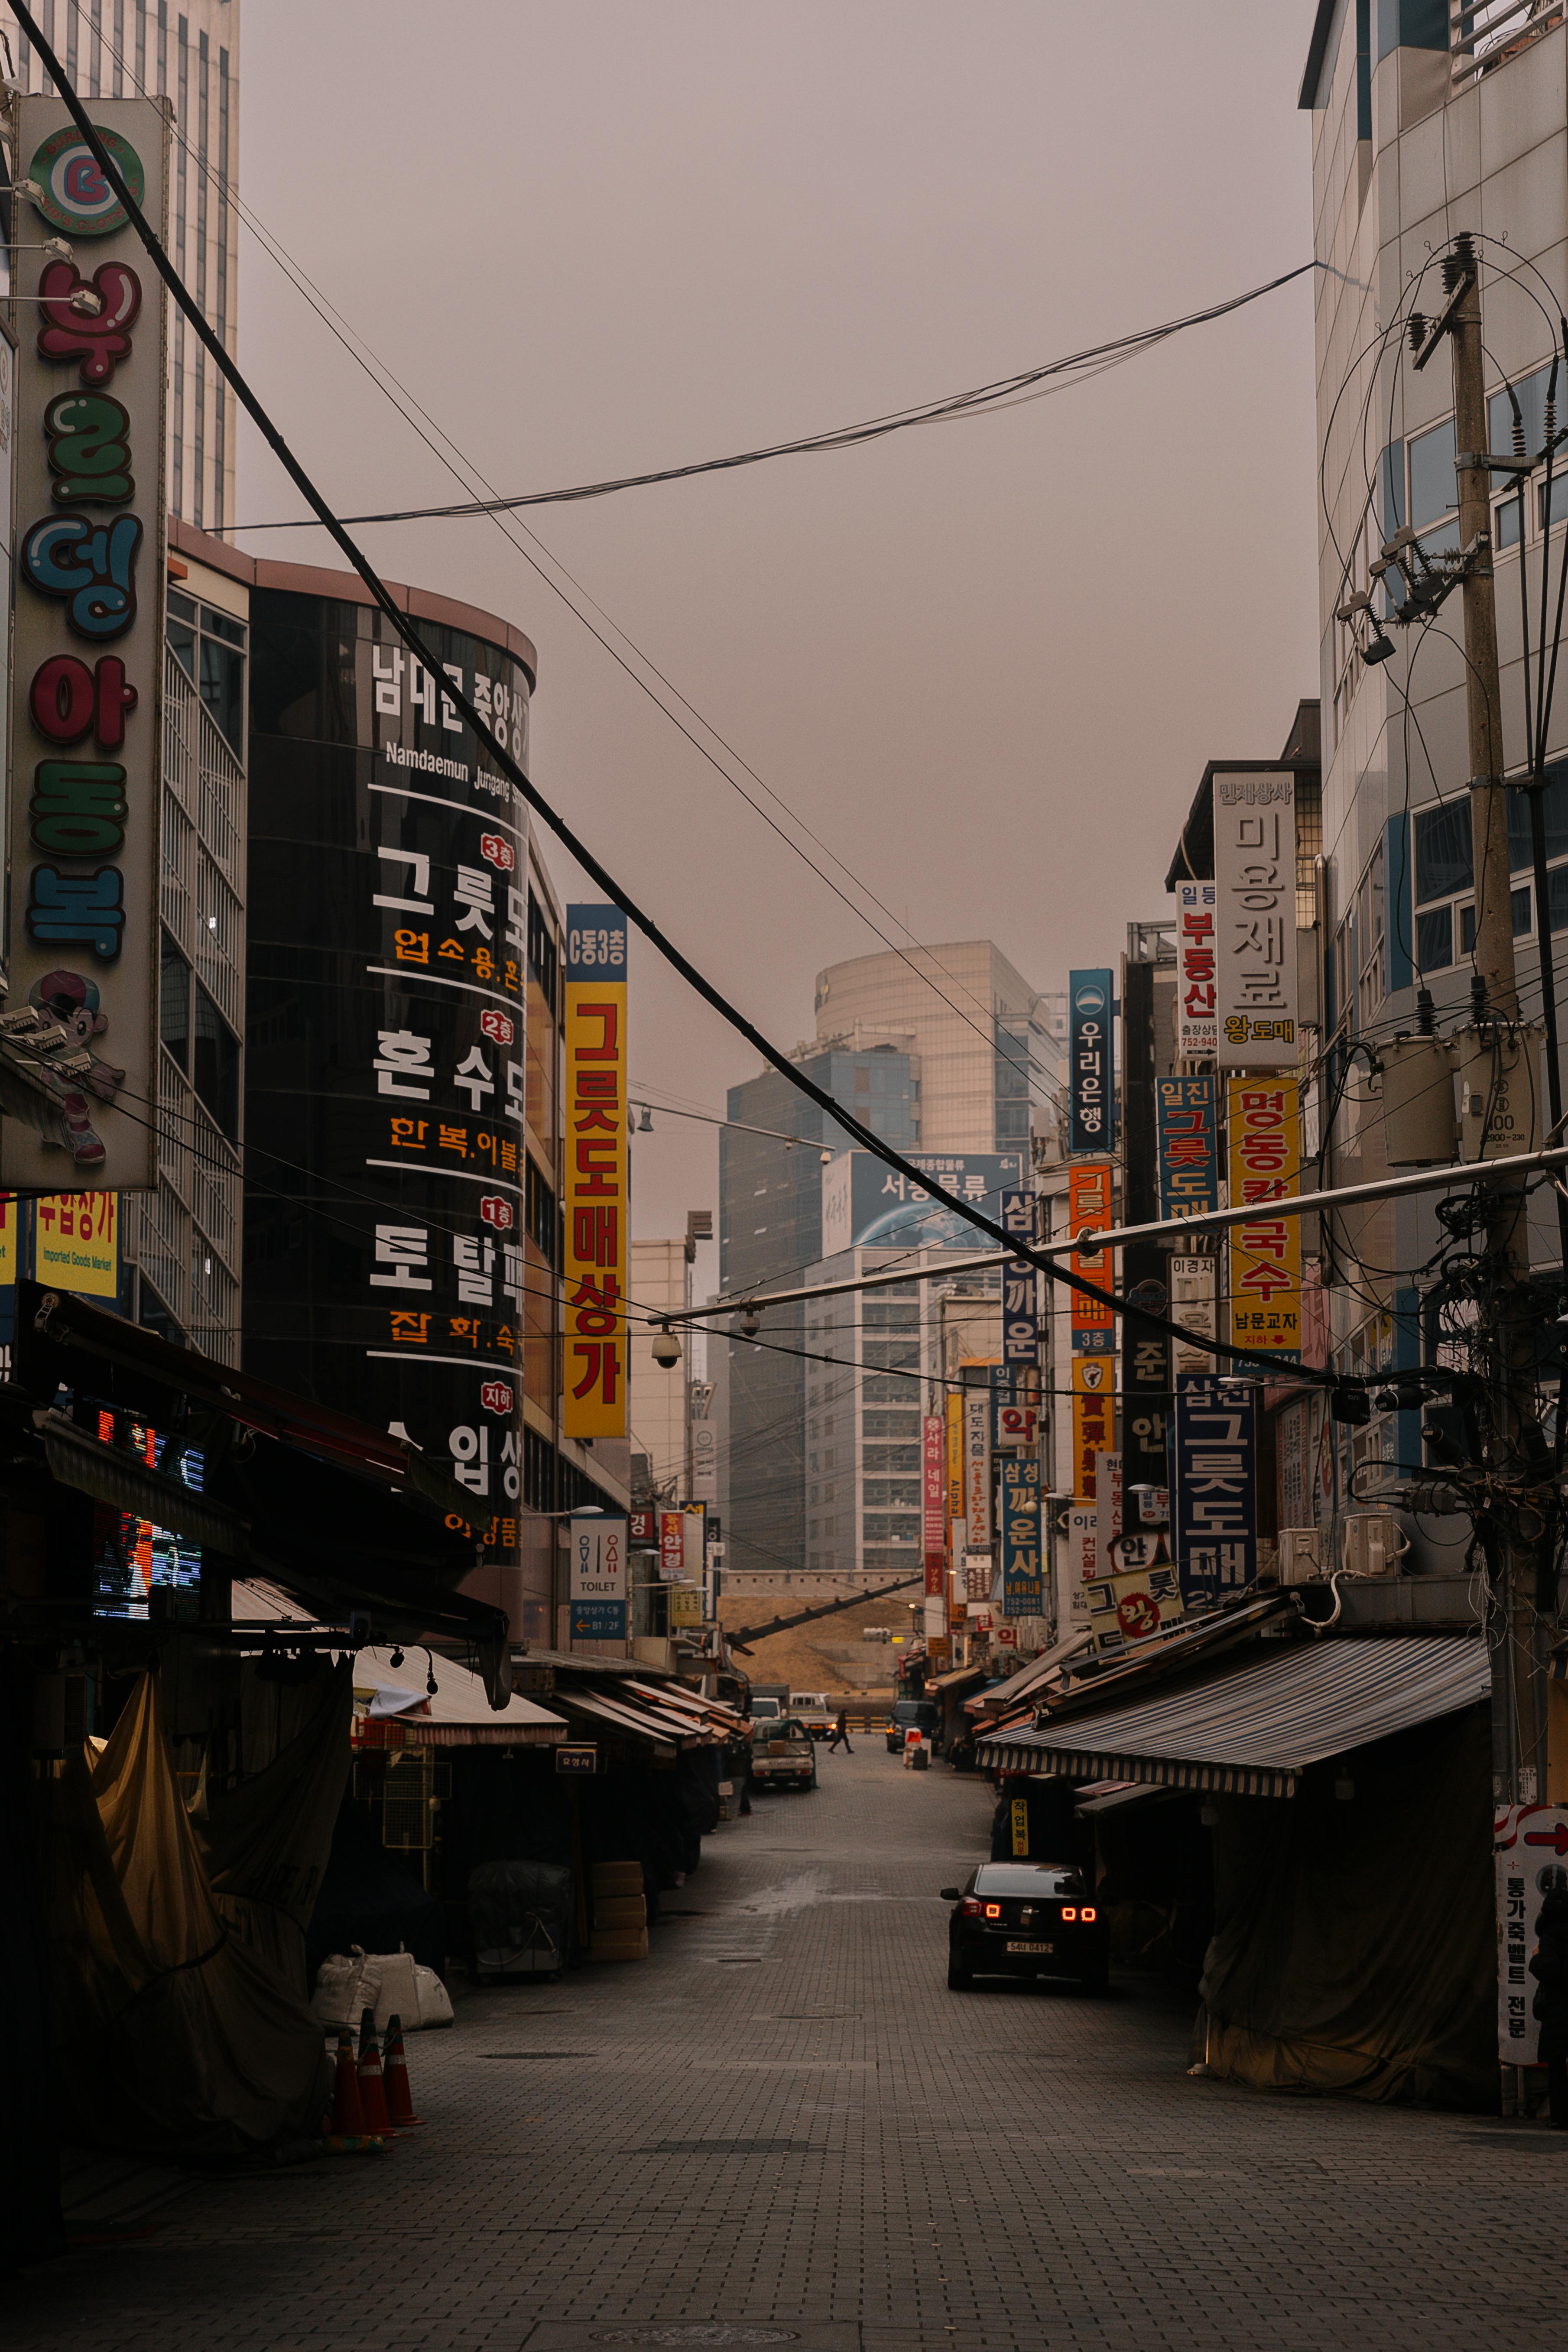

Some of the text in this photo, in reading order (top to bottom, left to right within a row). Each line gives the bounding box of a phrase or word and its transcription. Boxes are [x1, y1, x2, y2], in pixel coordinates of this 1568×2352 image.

[373, 645, 463, 733] 남대문
[386, 741, 468, 782] Namdaemun
[474, 766, 510, 802] Jungang
[1219, 783, 1292, 805] 민재상사
[485, 840, 511, 865] 3층
[1231, 812, 1287, 1010] 미용재료
[1182, 913, 1216, 1018] 부동산
[485, 1015, 511, 1040] 2층
[1078, 1022, 1102, 1132] 우리은행
[1161, 1081, 1208, 1106] 일진
[1076, 1173, 1104, 1216] 그릇
[486, 1203, 510, 1223] 1층
[43, 1247, 112, 1271] Imported Goods Market
[1173, 1260, 1214, 1273] 이경자
[1235, 1312, 1297, 1330] 남문교자
[1082, 1332, 1104, 1347] 3층
[1245, 1335, 1268, 1345] 지하
[485, 1388, 510, 1408] 지하
[1003, 1409, 1037, 1442] 약
[928, 1468, 940, 1498] 네일
[1005, 1463, 1039, 1483] 삼성
[1184, 1414, 1249, 1584] 그릇도매
[631, 1514, 645, 1536] 경
[664, 1536, 682, 1567] 안경
[1121, 1538, 1148, 1567] 안
[581, 1582, 616, 1592] TOILET
[576, 1606, 620, 1616] 중앙상가 C동
[1120, 1599, 1154, 1631] 왕
[592, 1621, 602, 1630] B1
[609, 1621, 620, 1630] 2F
[1029, 1943, 1049, 1952] 0412
[1508, 1996, 1526, 2039] 전문
